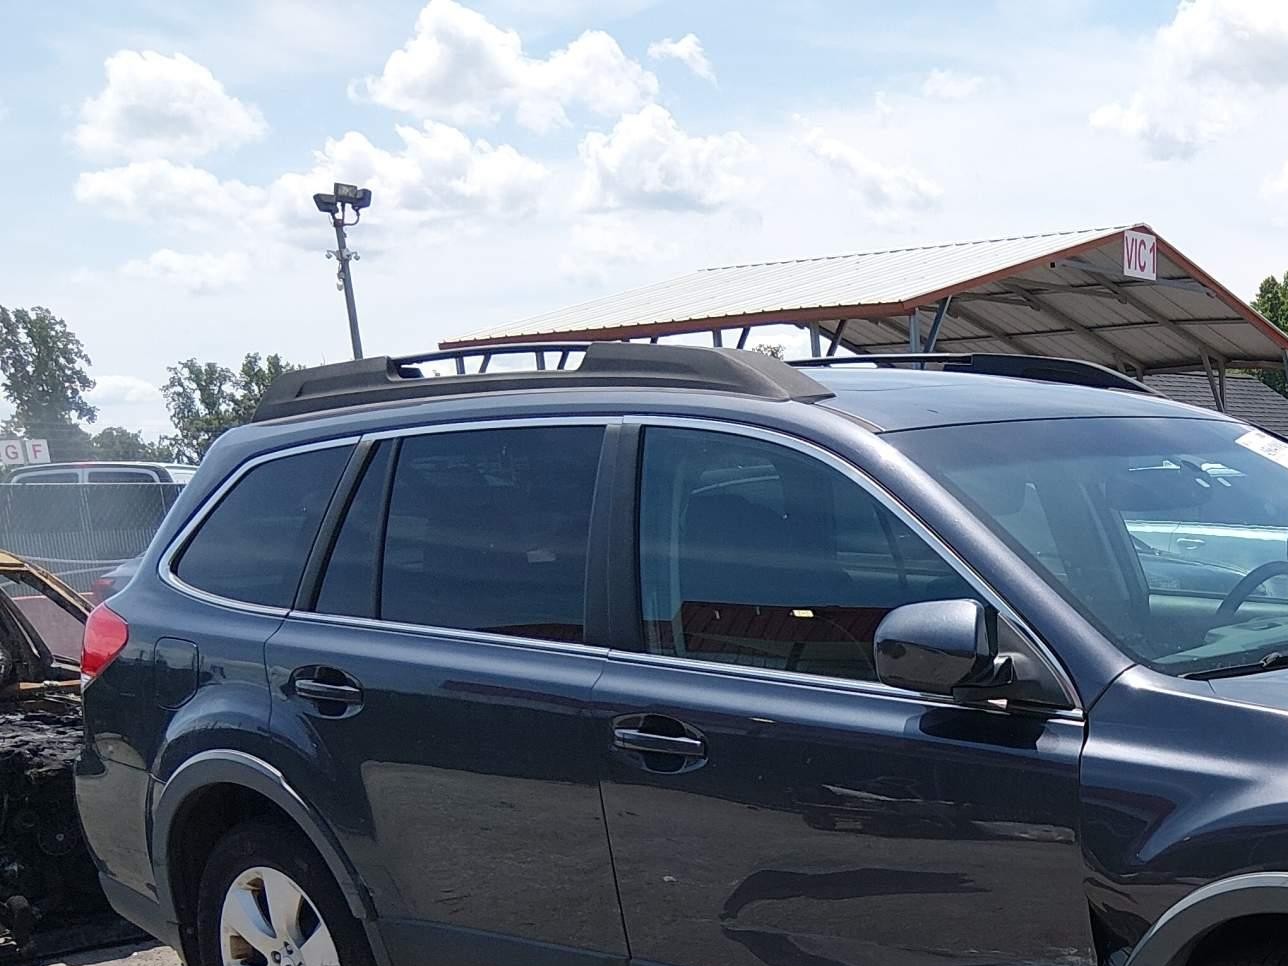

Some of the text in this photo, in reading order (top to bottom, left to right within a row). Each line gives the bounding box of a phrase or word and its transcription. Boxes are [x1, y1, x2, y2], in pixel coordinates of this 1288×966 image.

[1125, 236, 1156, 275] VIC 1
[5, 444, 19, 460] G
[31, 443, 42, 459] F
